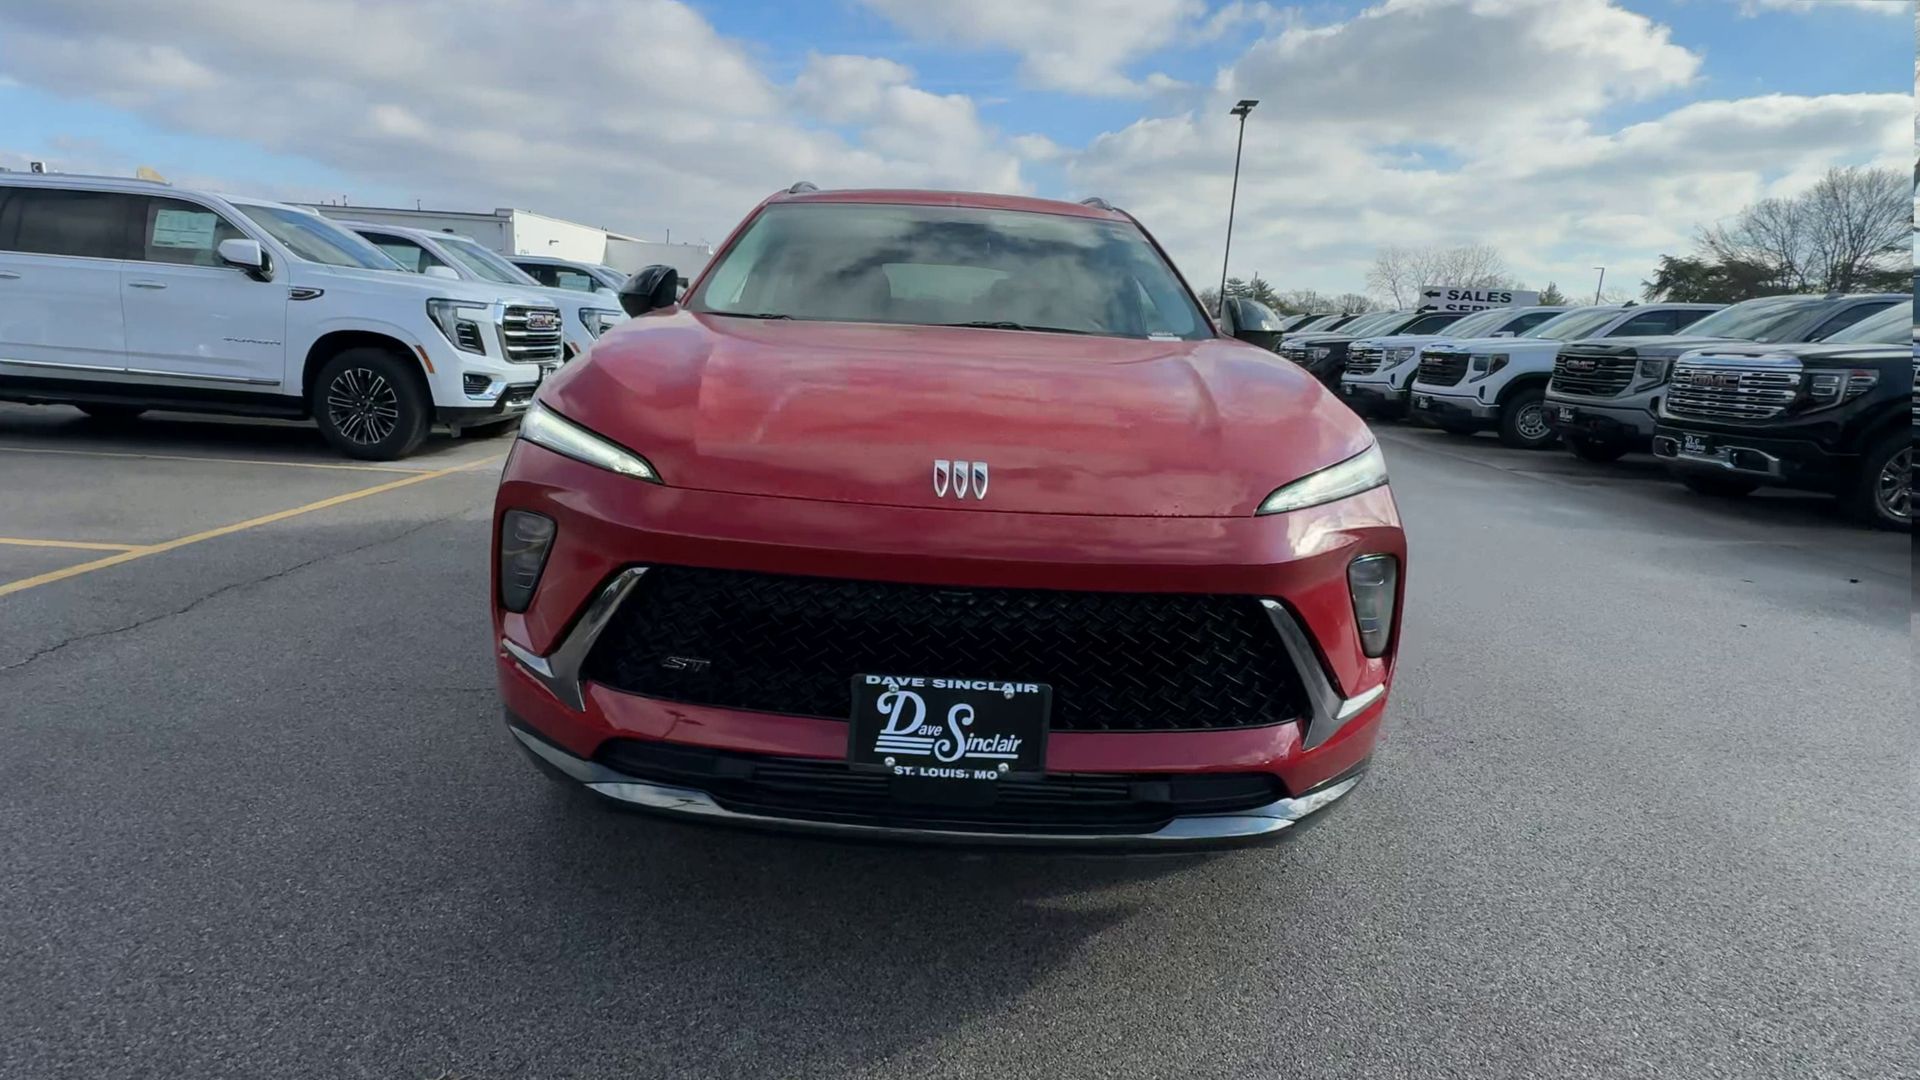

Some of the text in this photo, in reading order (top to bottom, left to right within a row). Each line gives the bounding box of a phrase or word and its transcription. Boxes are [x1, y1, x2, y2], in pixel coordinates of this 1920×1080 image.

[1447, 289, 1512, 304] SALES
[865, 675, 1039, 693] DAVE SINCLAIR
[876, 690, 1022, 762] Dave Sinclair
[893, 765, 916, 776] ST.
[974, 770, 998, 780] MO
